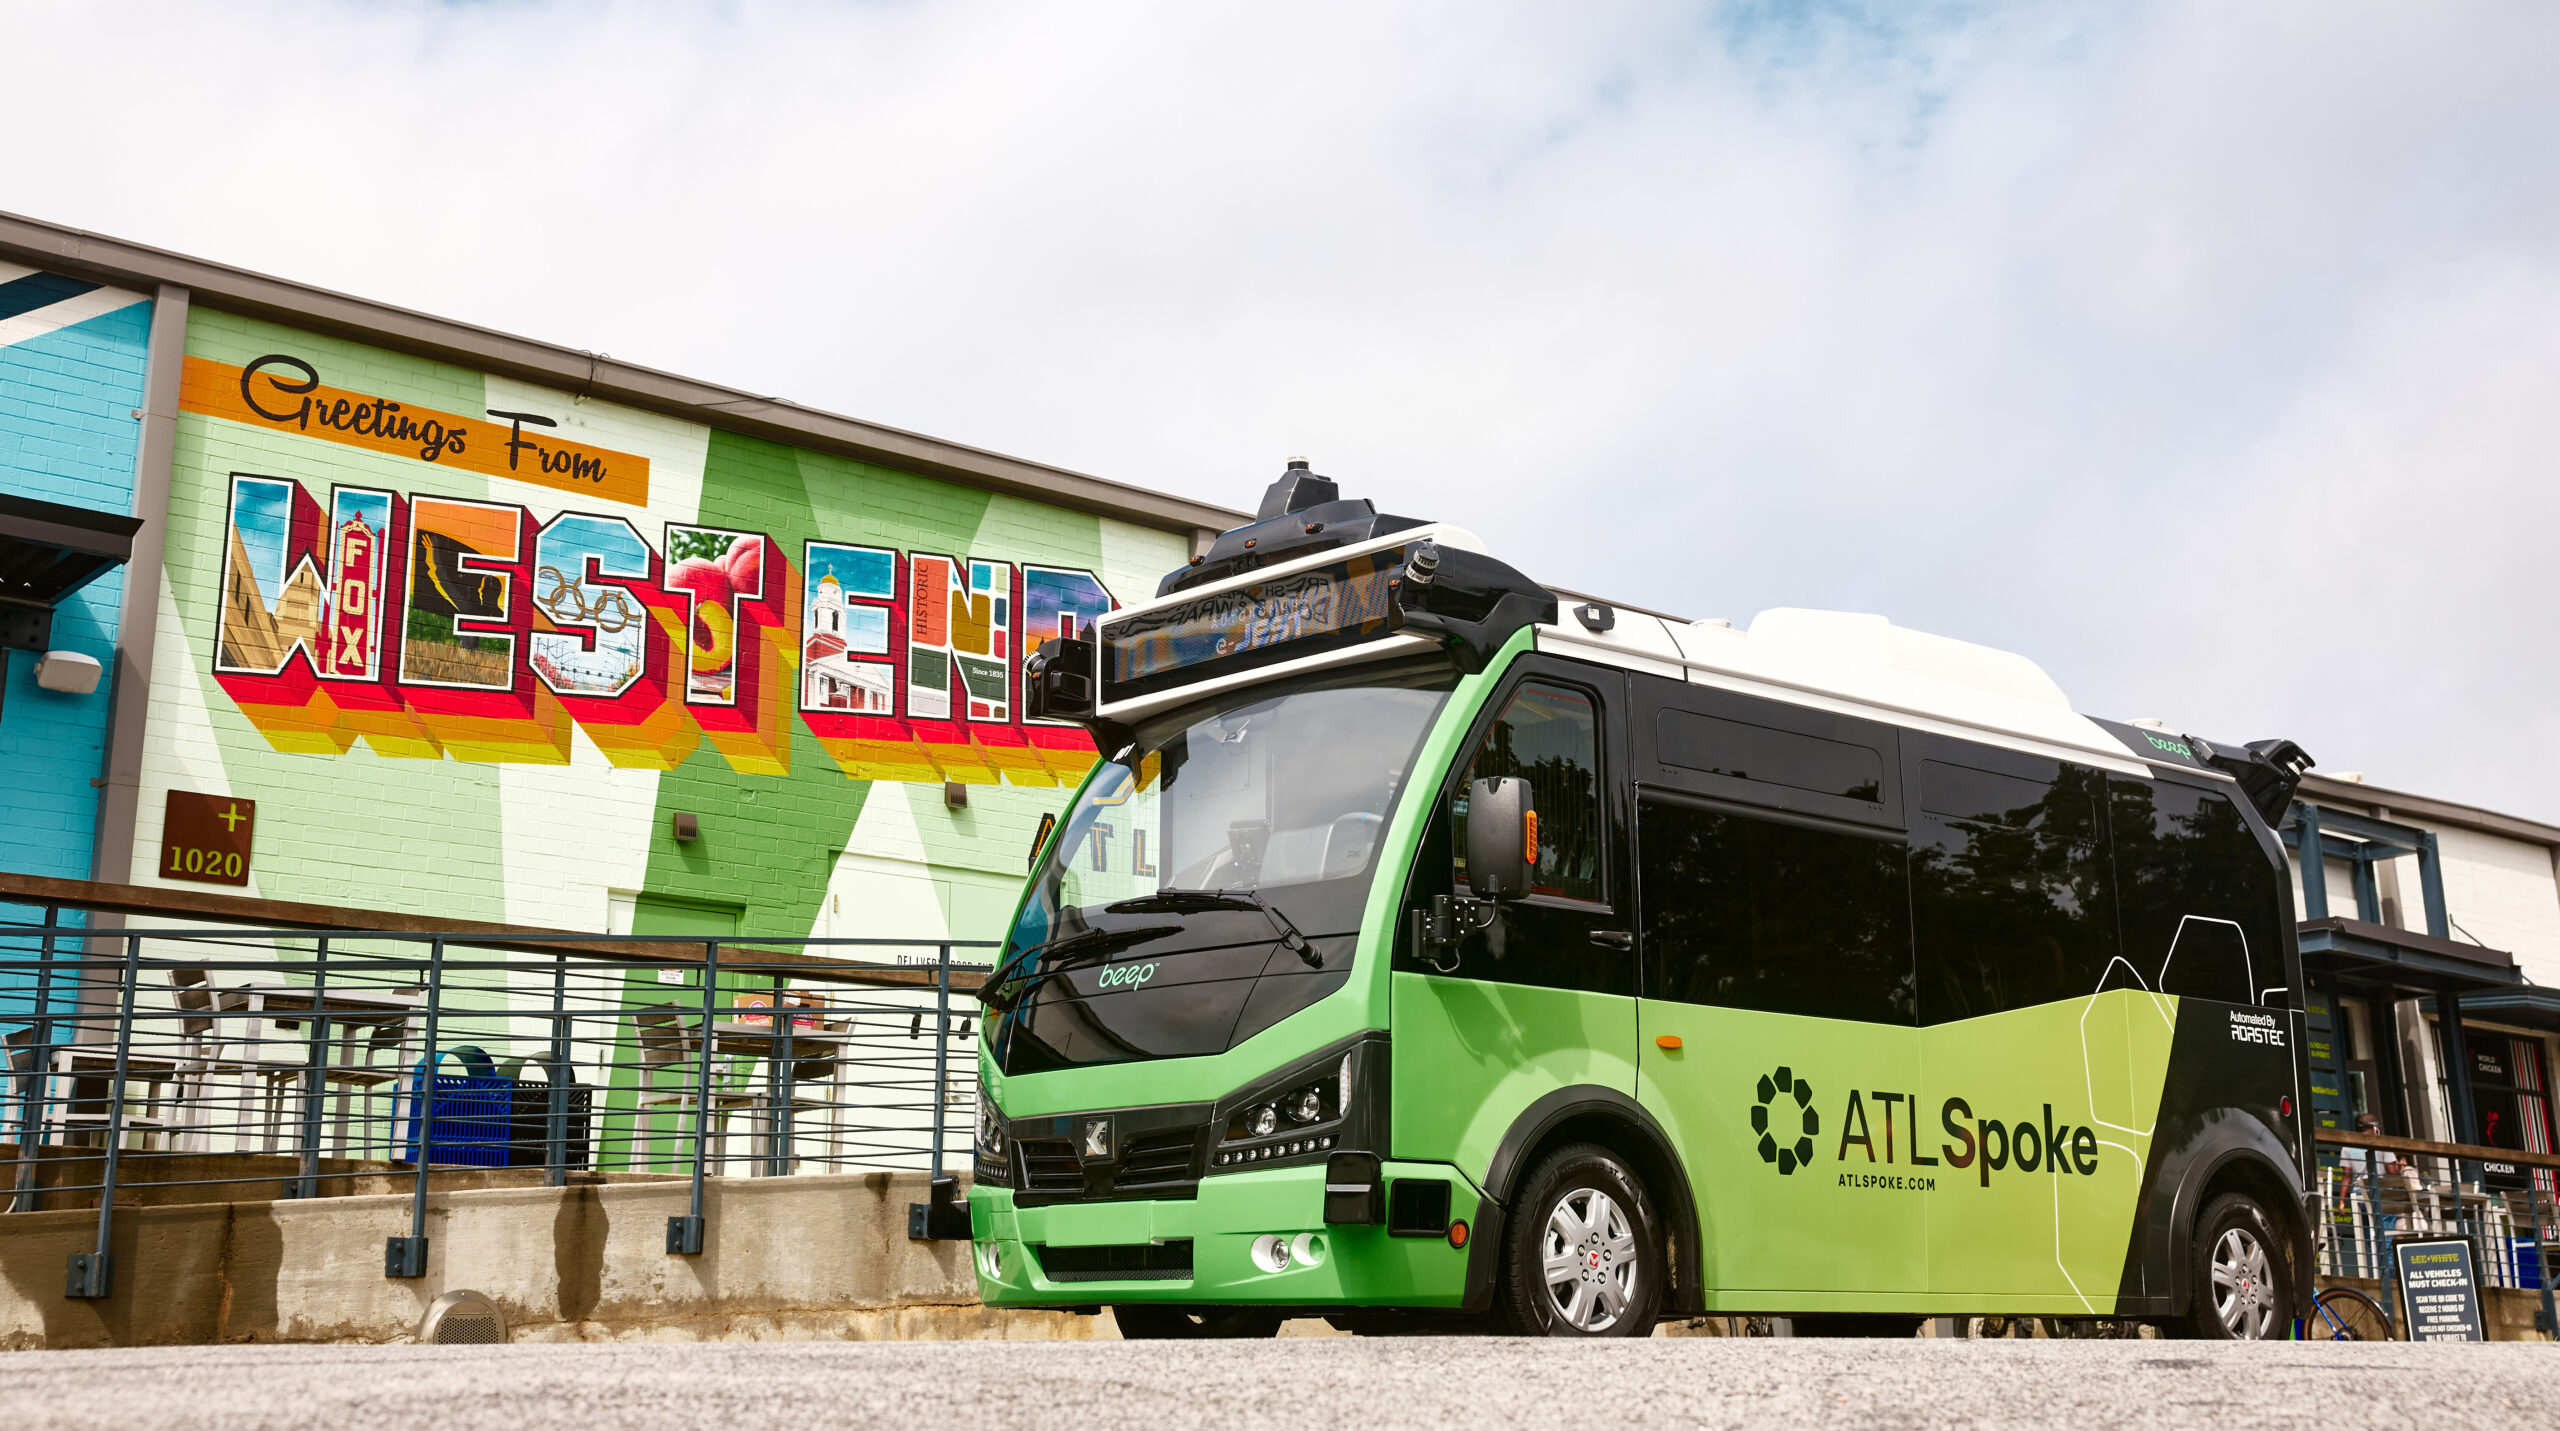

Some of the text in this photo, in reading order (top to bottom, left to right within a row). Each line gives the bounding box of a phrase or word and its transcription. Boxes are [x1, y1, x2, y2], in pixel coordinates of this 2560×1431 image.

[240, 353, 608, 484] Greetings From
[212, 471, 768, 708] WEST
[915, 561, 929, 636] HISTORIC
[338, 537, 368, 668] FOX
[972, 666, 1004, 679] Since 1835
[2142, 731, 2190, 760] beep
[169, 845, 243, 878] 1020
[2230, 1010, 2276, 1029] Automated By
[2230, 1024, 2286, 1047] ADASTEC
[2478, 1063, 2502, 1074] CHICKEN
[1838, 1089, 2099, 1188] ATLSpoke
[2483, 1162, 2515, 1174] CHICKEN
[1838, 1173, 1936, 1191] ATLSPOKE.COM
[2408, 1278, 2468, 1289] MUST CHECK-IN
[2410, 1269, 2462, 1280] ALL VEHICLES
